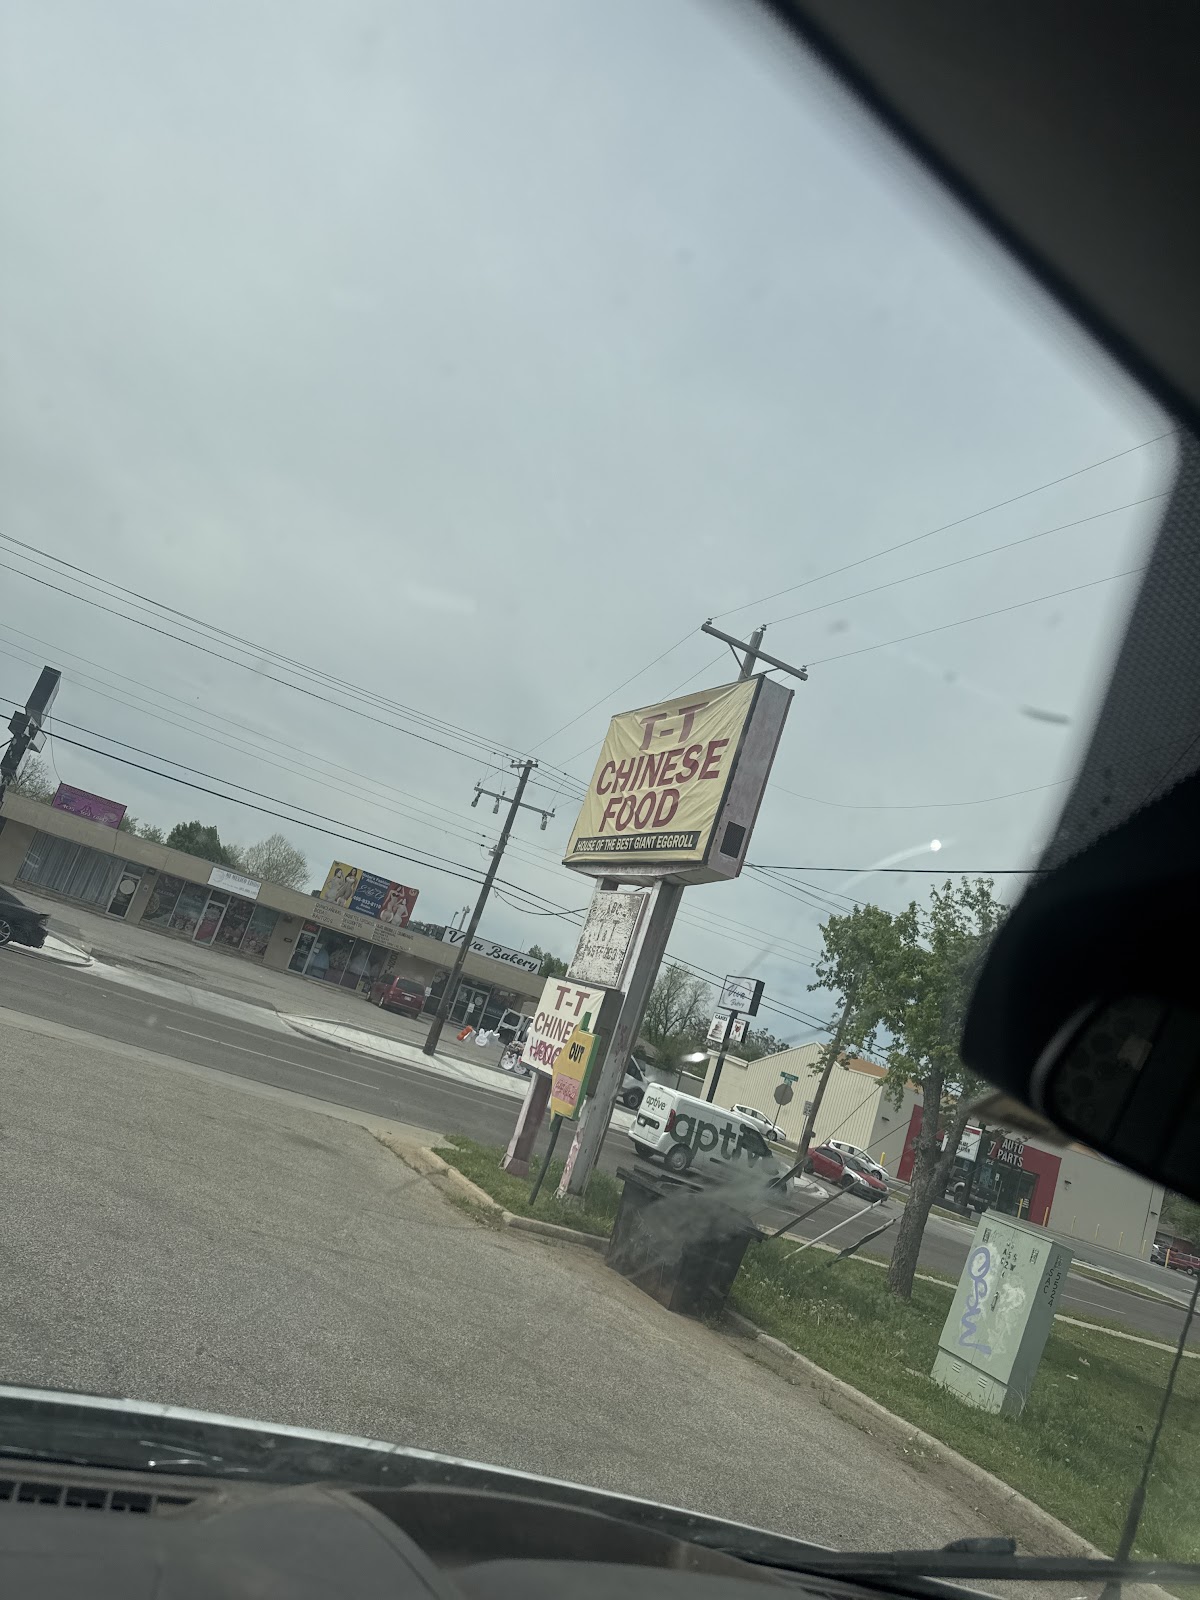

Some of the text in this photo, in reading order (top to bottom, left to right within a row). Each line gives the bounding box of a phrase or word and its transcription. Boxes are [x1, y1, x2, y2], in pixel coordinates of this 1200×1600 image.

[639, 702, 709, 751] T-T
[596, 738, 730, 796] CHINESE
[599, 788, 680, 833] FOOD
[576, 834, 693, 851] HOUSE OF THE BEST GIANT EGGROLL
[486, 944, 538, 972] Bakery
[556, 986, 590, 1017] T-T
[569, 1042, 585, 1063] OUT
[646, 1095, 666, 1111] aptive
[670, 1113, 762, 1167] apti
[1002, 1140, 1025, 1155] AUTO
[997, 1150, 1024, 1168] PARTS
